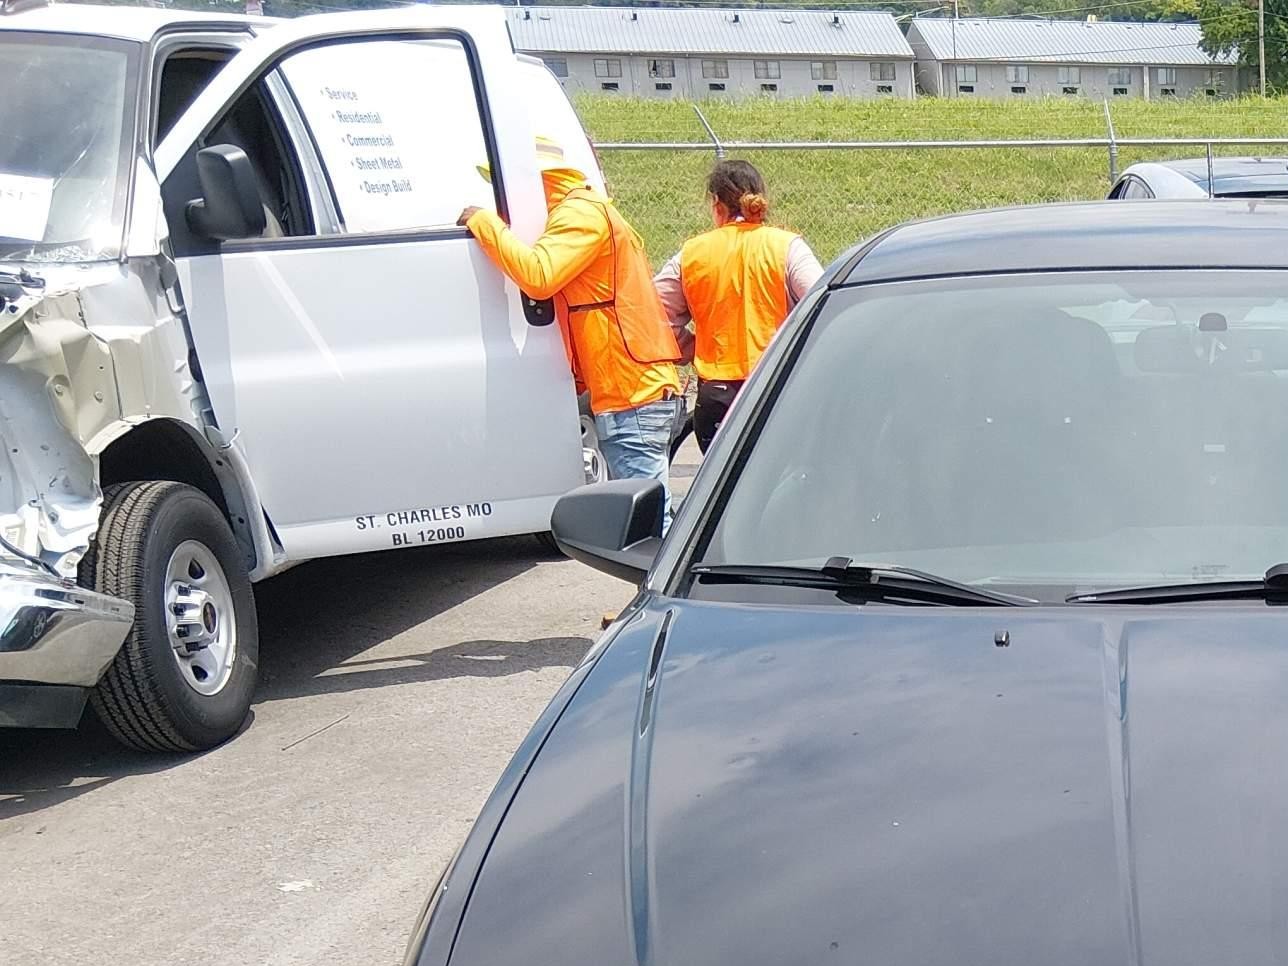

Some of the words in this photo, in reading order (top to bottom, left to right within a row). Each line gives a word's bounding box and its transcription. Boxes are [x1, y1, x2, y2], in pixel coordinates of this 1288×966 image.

[325, 86, 359, 101] Service
[336, 110, 382, 124] Residential
[346, 133, 394, 147] Commercial
[355, 157, 381, 170] Sheet
[380, 157, 403, 170] Metal
[363, 180, 392, 196] Design
[391, 179, 412, 193] Build
[356, 515, 381, 530] ST.
[386, 505, 461, 527] CHARLES
[466, 502, 492, 517] MO
[391, 532, 413, 546] BL
[417, 526, 465, 543] 12000
